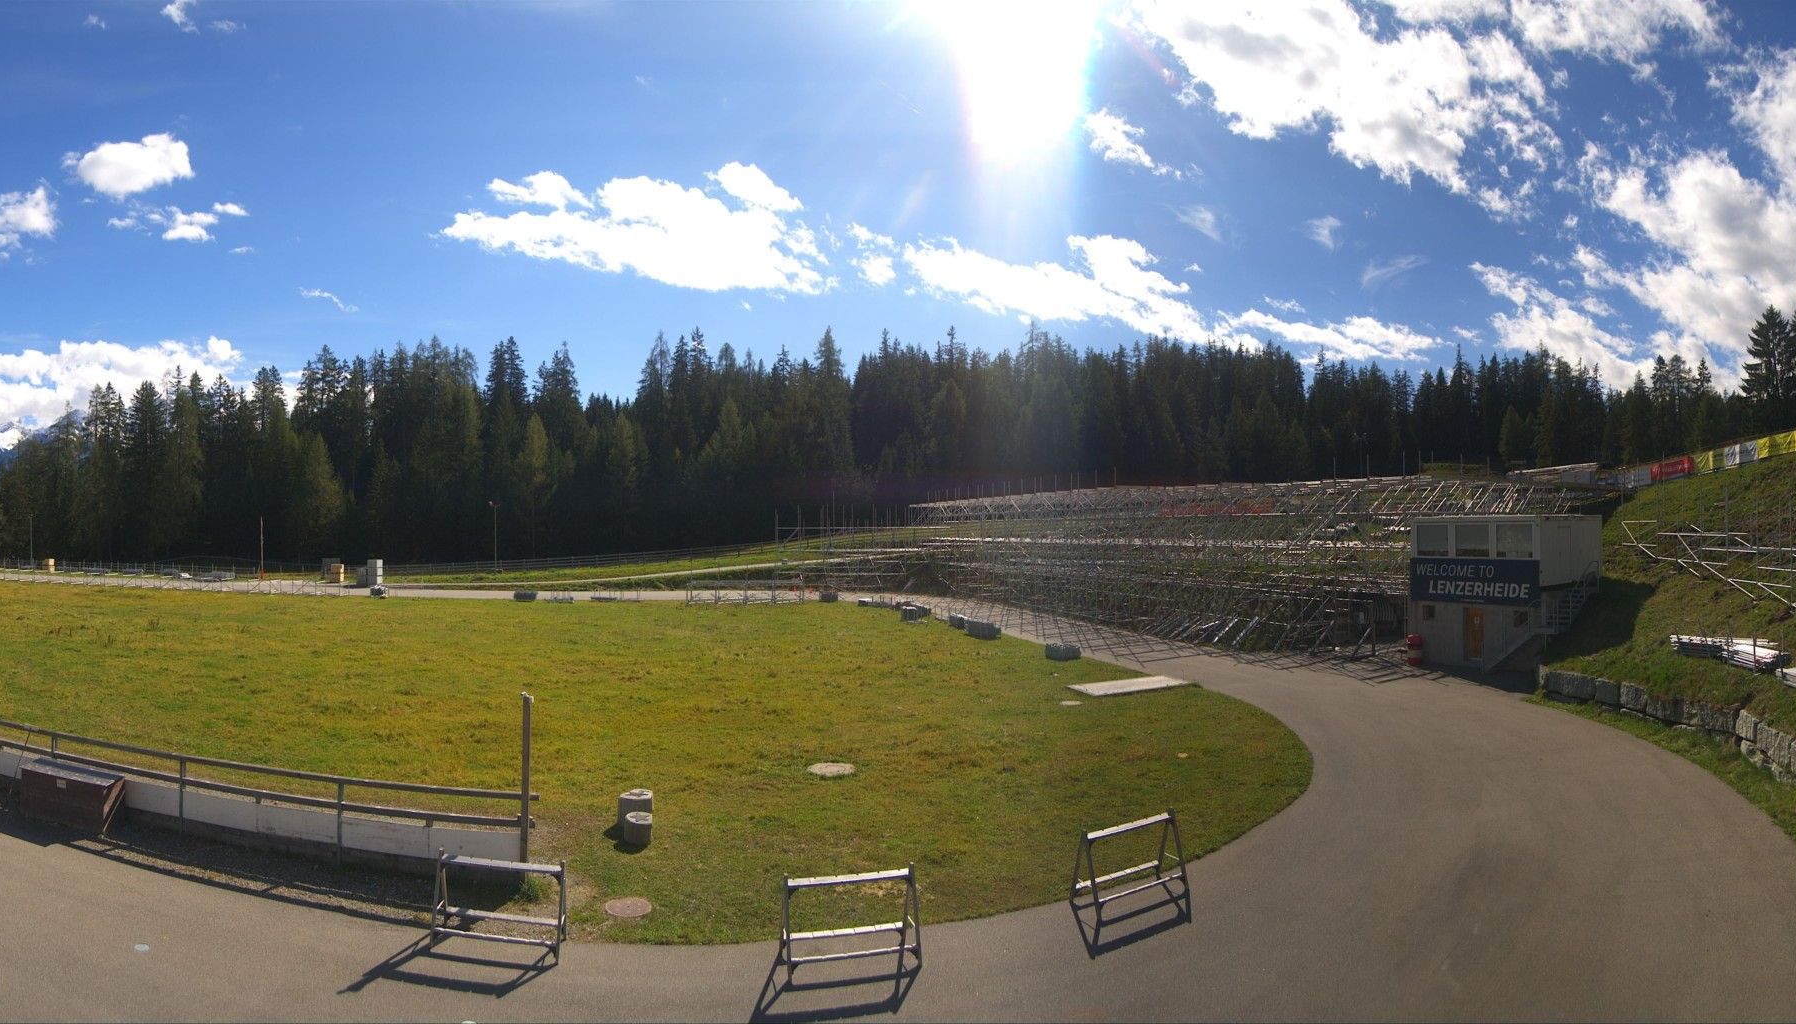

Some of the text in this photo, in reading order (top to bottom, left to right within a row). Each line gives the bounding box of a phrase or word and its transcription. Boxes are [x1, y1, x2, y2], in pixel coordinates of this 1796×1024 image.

[1416, 563, 1495, 578] WELCOME TO
[1428, 580, 1530, 598] LENZERHEIDE
